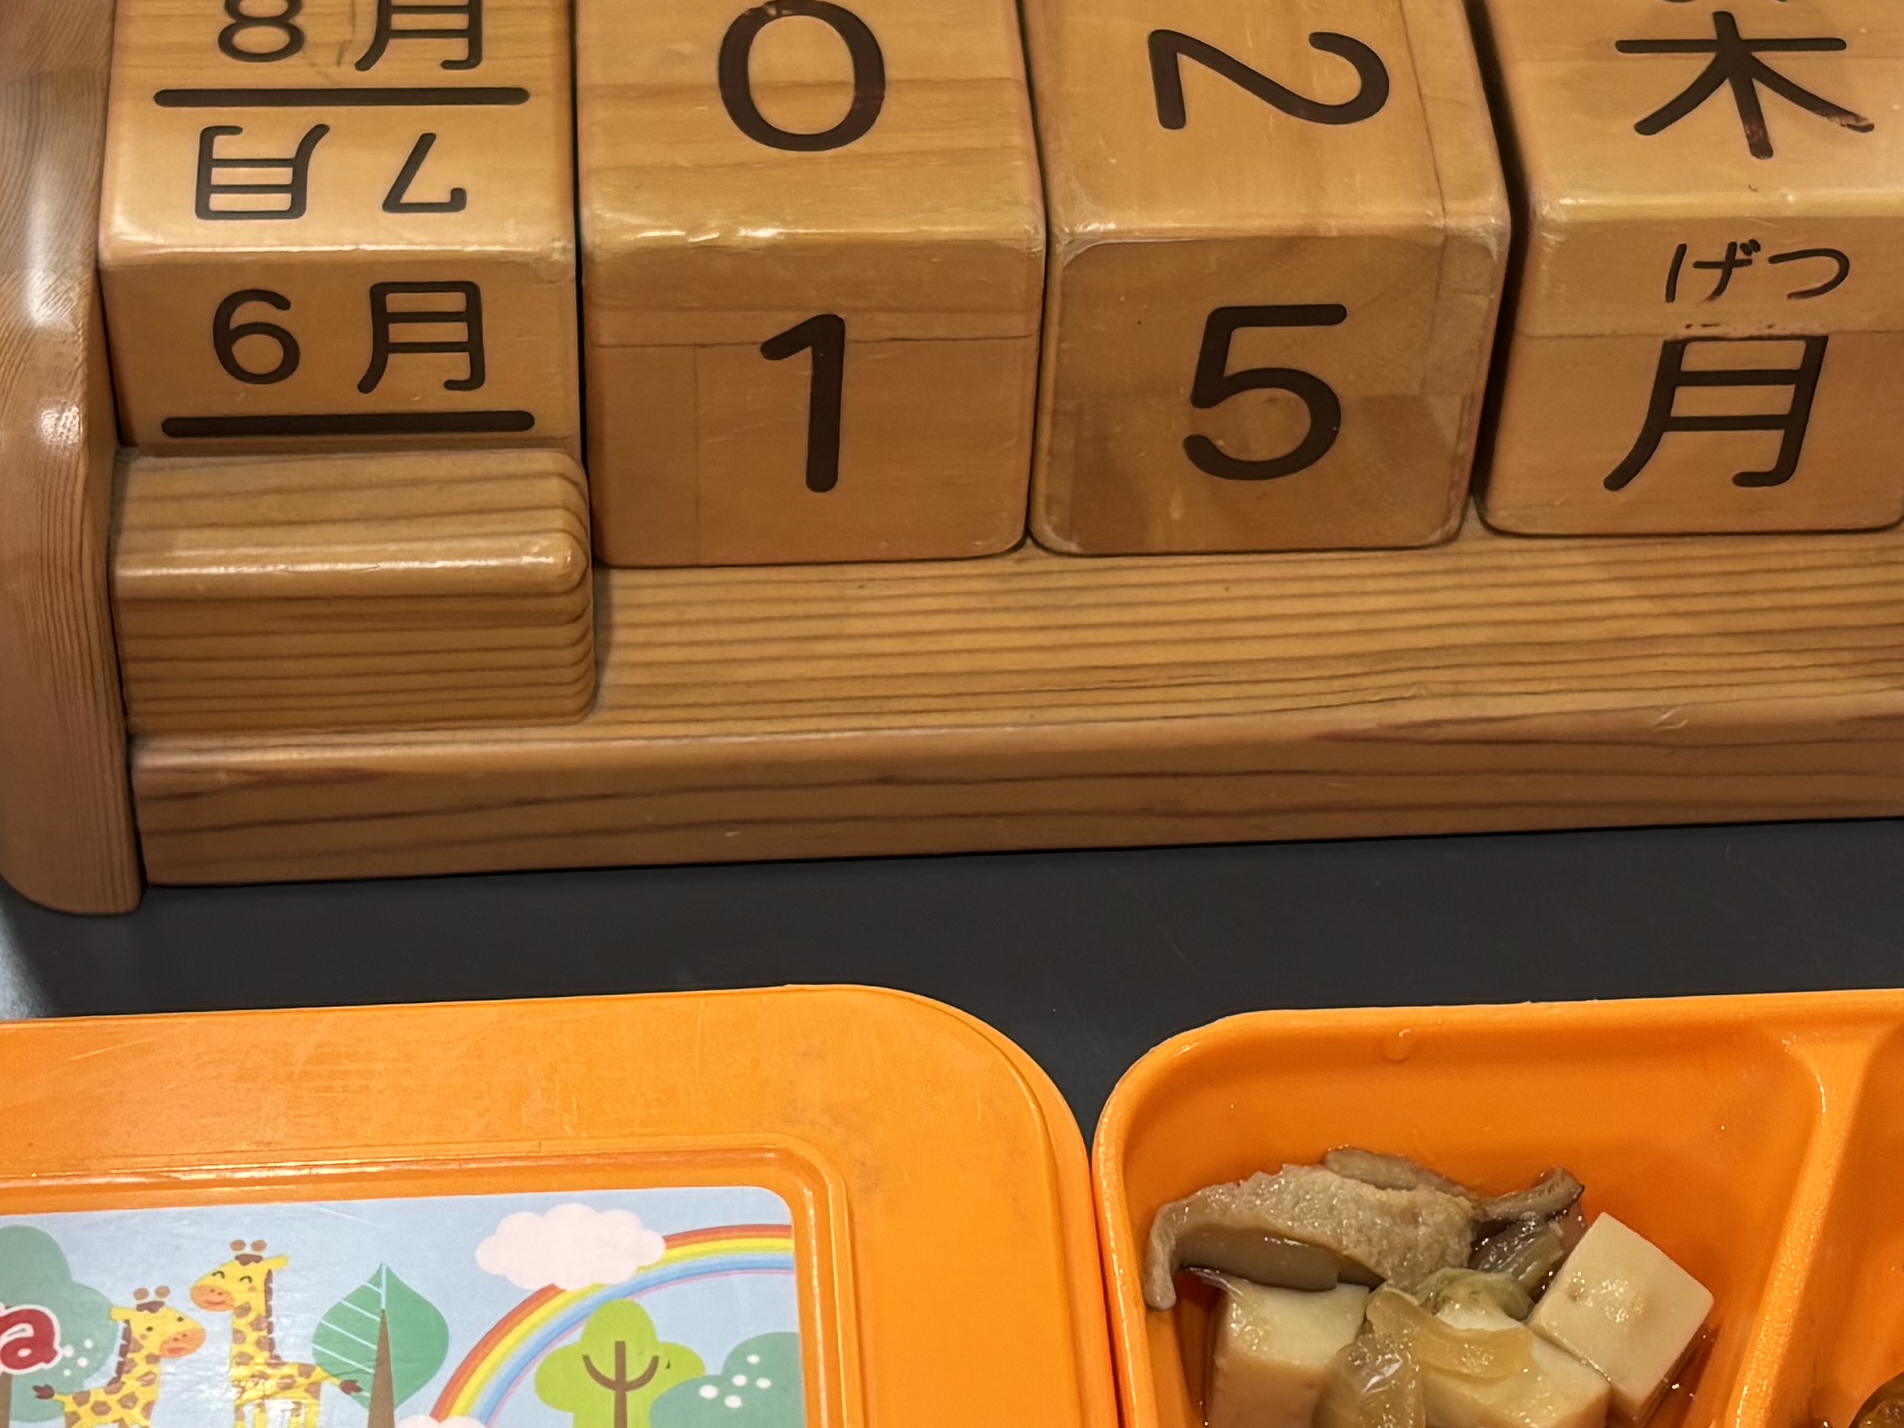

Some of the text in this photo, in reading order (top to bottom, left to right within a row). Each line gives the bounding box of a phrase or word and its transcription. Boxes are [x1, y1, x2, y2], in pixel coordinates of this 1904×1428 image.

[1148, 28, 1390, 130] 2
[1614, 10, 1876, 161] 木
[194, 122, 469, 221] 7月
[1663, 238, 1851, 304] げつ
[211, 279, 1830, 494] 6月 1 5 月
